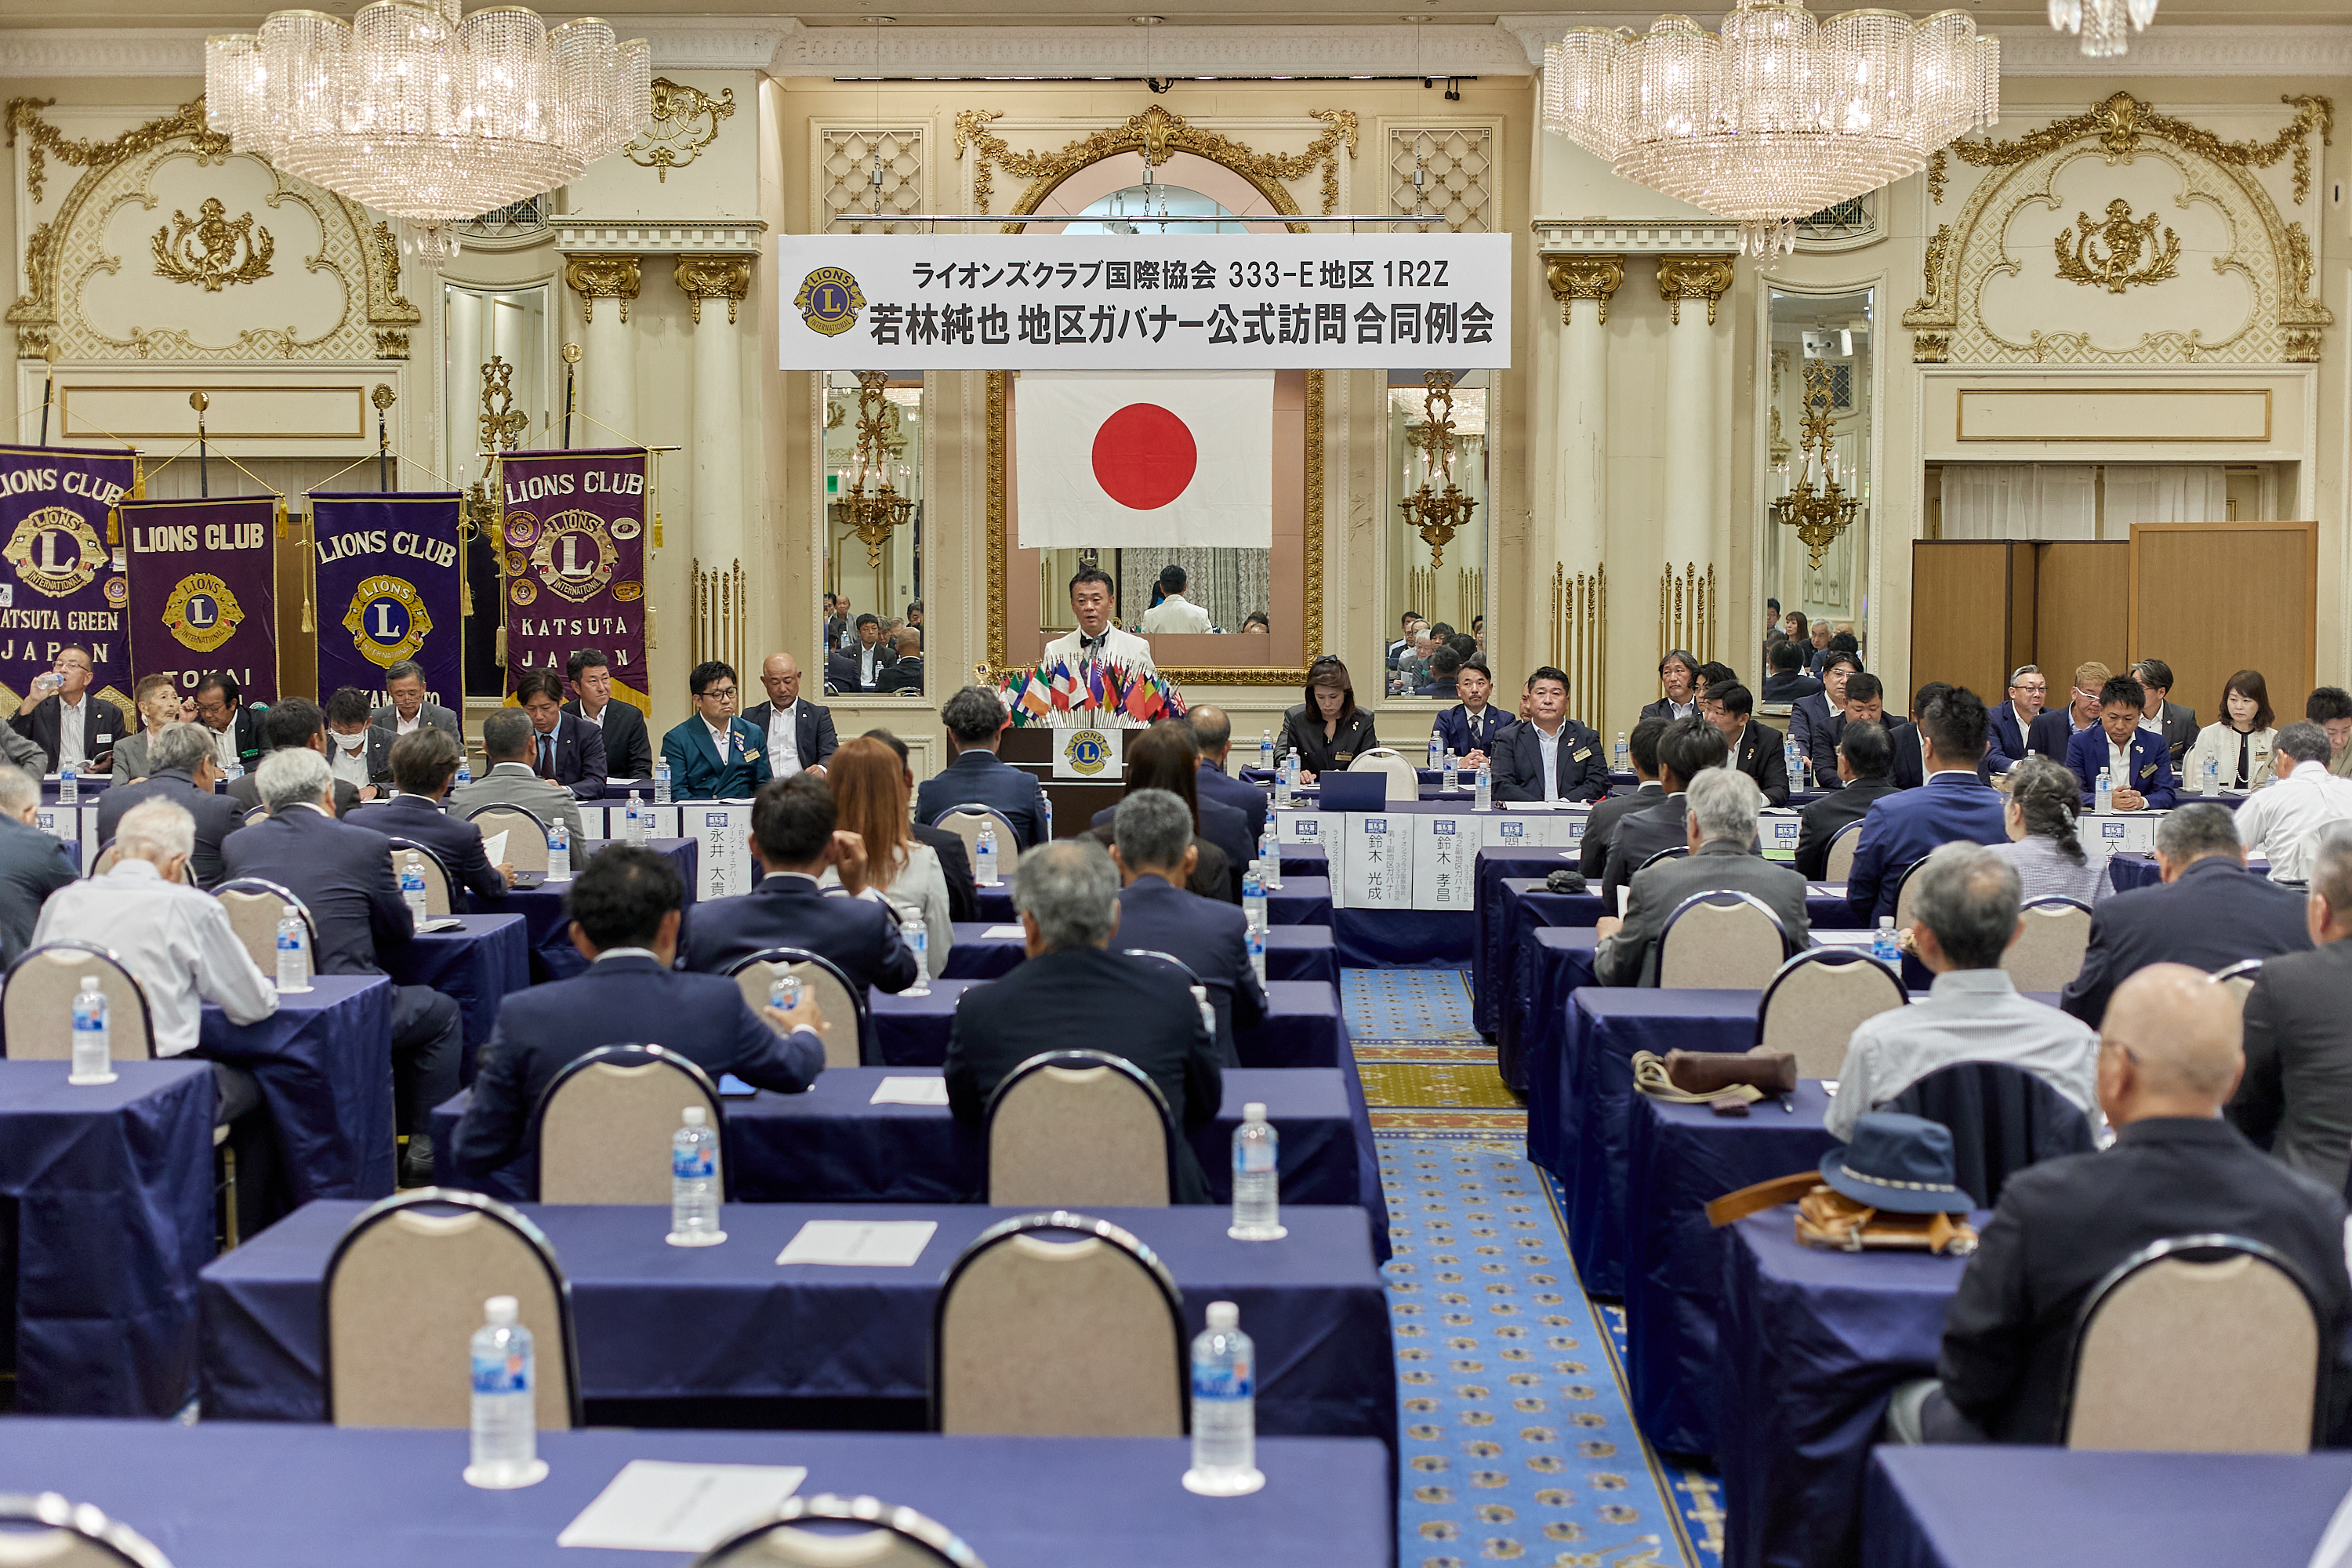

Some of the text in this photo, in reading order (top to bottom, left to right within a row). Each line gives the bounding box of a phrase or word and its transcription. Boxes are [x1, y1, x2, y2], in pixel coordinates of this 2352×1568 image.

[809, 270, 851, 285] LIONS
[913, 260, 1217, 290] ライオンズクラブ国際協会
[1383, 261, 1449, 287] 1R2Z
[822, 289, 841, 312] L
[810, 318, 852, 332] INTERNATIONAL
[63, 471, 125, 508] CLUB
[505, 470, 644, 505] LIONS CLUB
[34, 512, 81, 531] LIONS
[551, 514, 600, 534] LIONS
[132, 523, 264, 553] LIONS CLUB
[40, 532, 75, 572] L
[315, 529, 457, 568] LIONS CLUB
[561, 535, 594, 575] L
[28, 571, 82, 590] INTERNATIONAL
[183, 579, 221, 593] LIONS
[362, 580, 411, 600] LIONS
[554, 576, 601, 596] INTERNATIONAL
[0, 609, 119, 631] ATSUTA GREEN
[191, 598, 214, 624] L
[374, 604, 400, 637] L
[521, 616, 627, 636] KATSUTA
[181, 630, 225, 644] INTERNATIONAL
[1, 640, 108, 663] JAPN
[362, 641, 413, 659] INTERNATIONAL
[521, 649, 628, 668] JAN
[1075, 732, 1102, 742] LIONS
[1083, 744, 1095, 760] L
